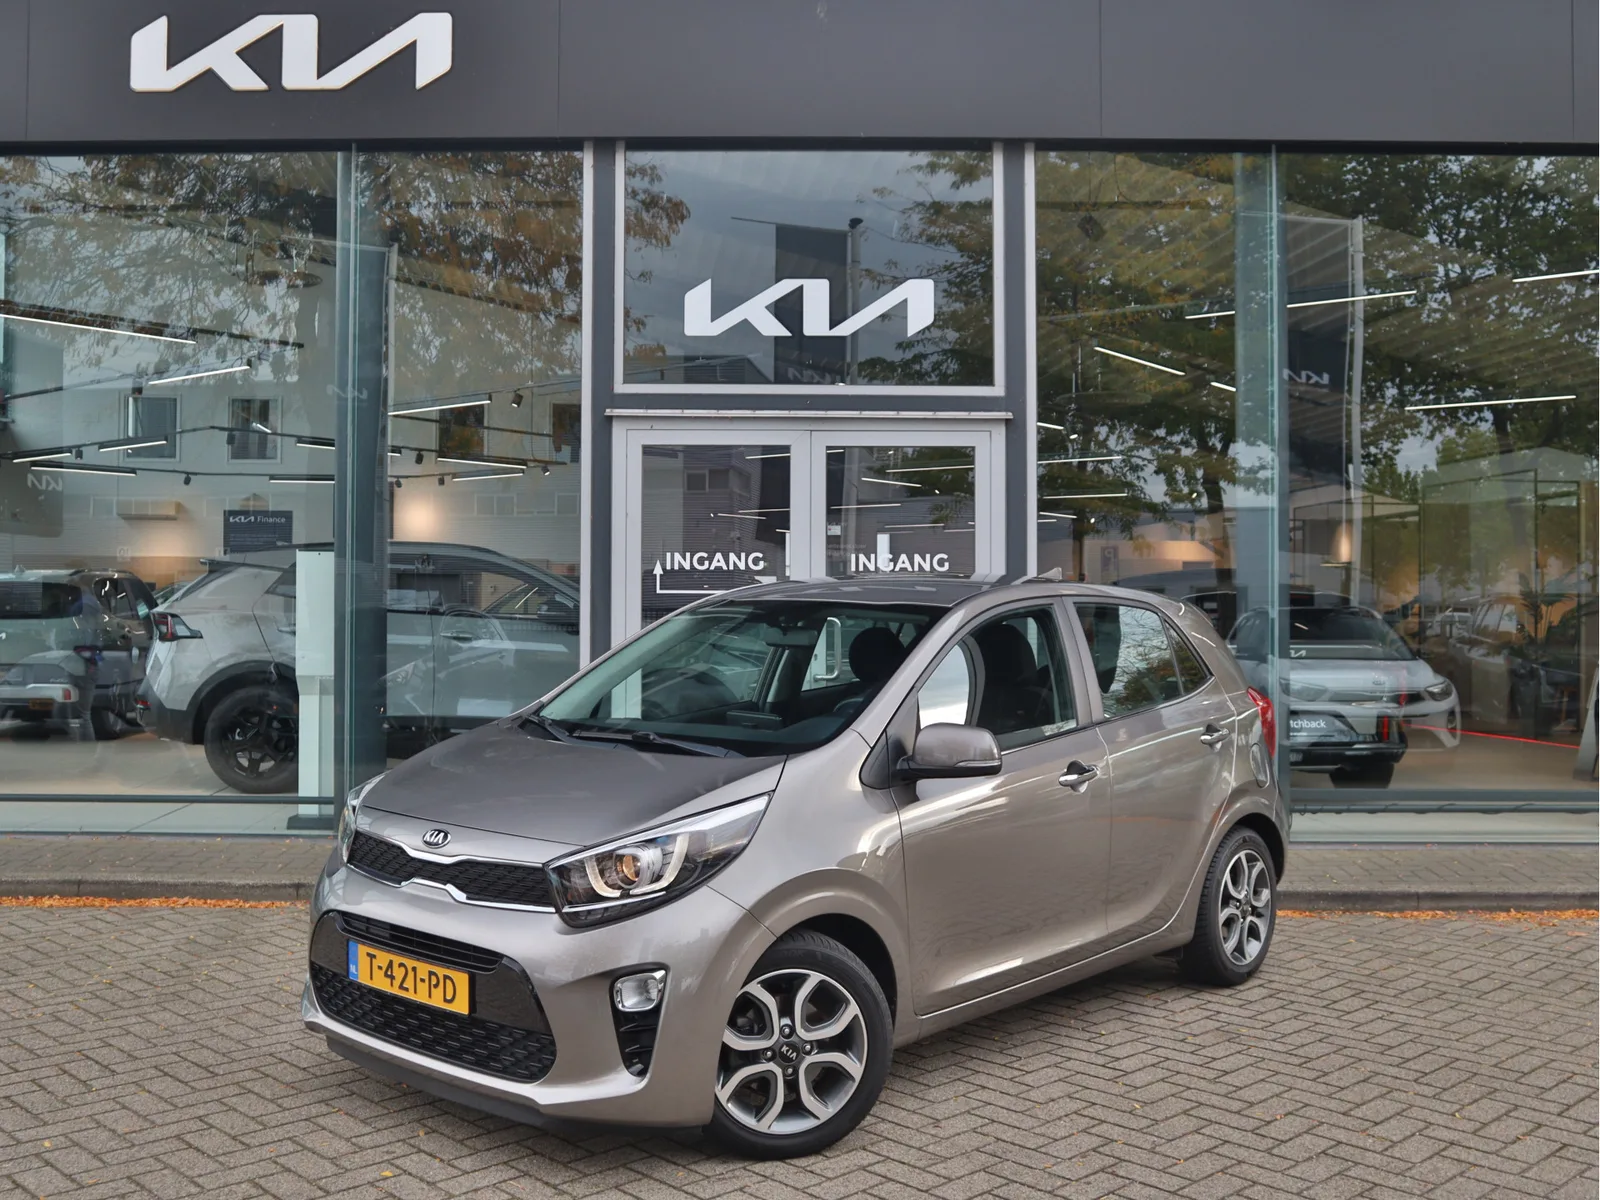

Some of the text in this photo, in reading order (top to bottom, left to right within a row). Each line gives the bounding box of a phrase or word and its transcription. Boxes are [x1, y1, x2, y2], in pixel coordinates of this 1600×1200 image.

[130, 12, 453, 92] KIA
[684, 278, 935, 336] KIA
[257, 515, 286, 523] Finance
[666, 552, 765, 570] INGANG
[850, 553, 949, 572] INGANG
[423, 830, 445, 844] KIA
[365, 951, 457, 1004] T-421-PD
[781, 1044, 797, 1060] KIA
